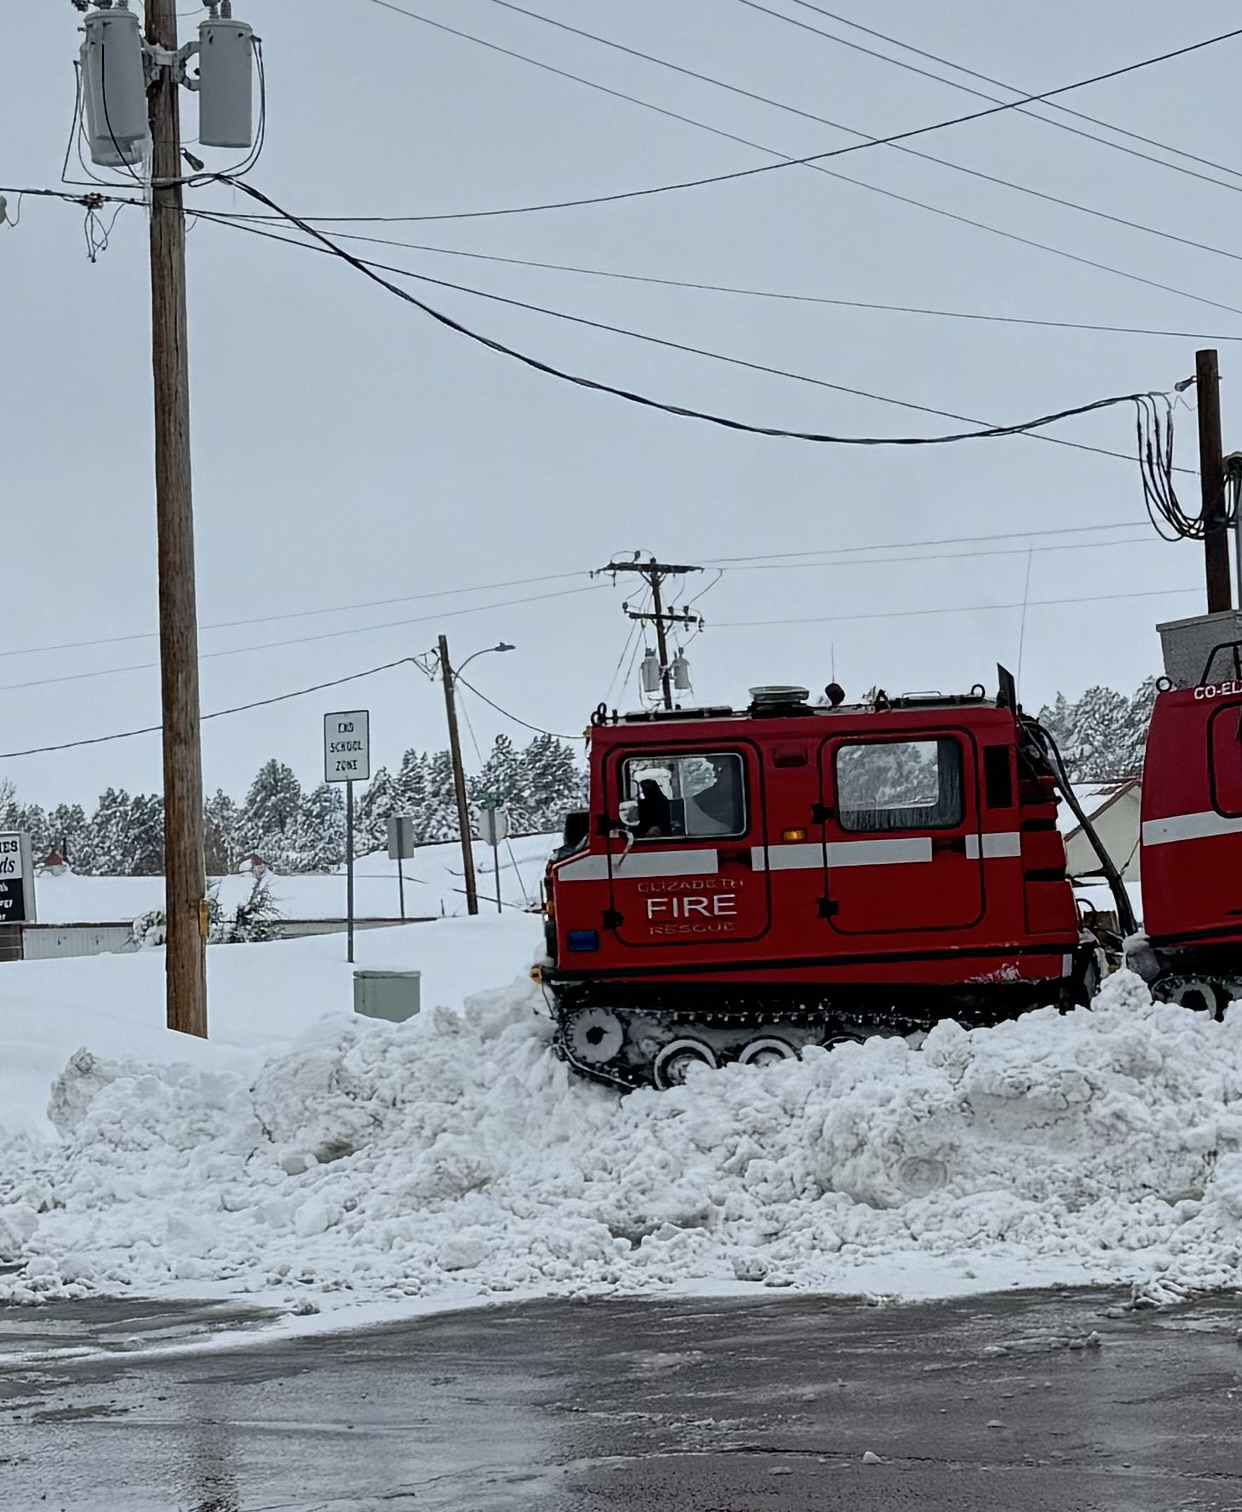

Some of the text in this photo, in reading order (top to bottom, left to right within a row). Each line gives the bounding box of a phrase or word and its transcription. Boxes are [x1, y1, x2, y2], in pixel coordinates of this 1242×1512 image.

[0, 840, 18, 854] ES
[637, 878, 744, 893] ELIZABETH
[647, 894, 738, 919] FIRE
[649, 922, 736, 935] RESCUE
